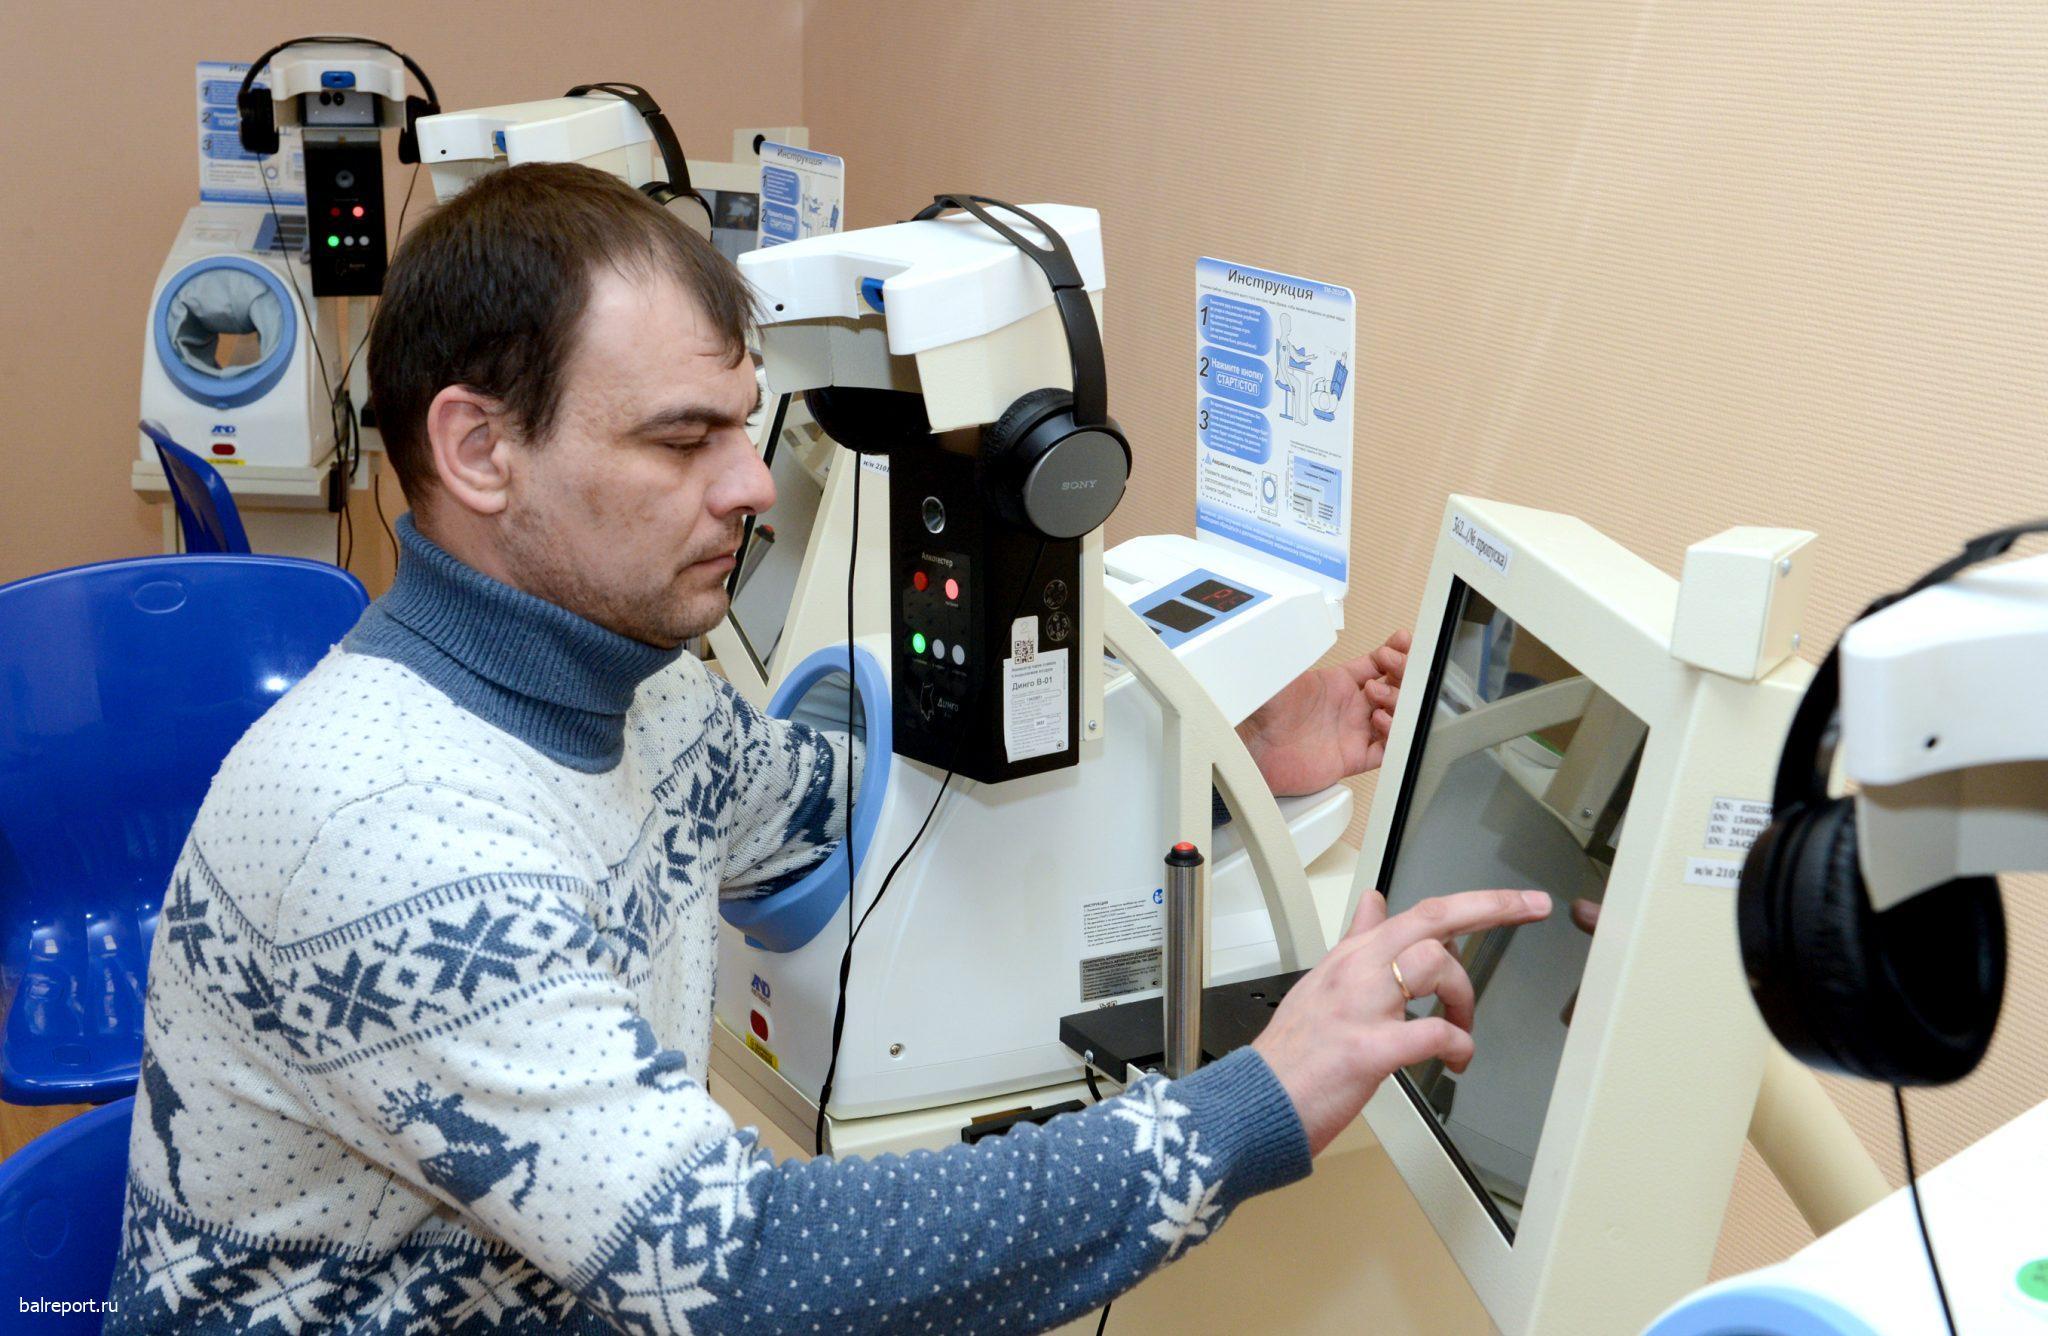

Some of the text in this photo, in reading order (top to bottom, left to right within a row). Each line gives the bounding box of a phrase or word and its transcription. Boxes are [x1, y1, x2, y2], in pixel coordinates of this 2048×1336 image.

[1227, 268, 1314, 301] Инструкция
[1200, 306, 1208, 326] 1
[1200, 357, 1209, 378] 2
[1211, 357, 1264, 382] Нажмите кнопку
[1199, 410, 1209, 430] 3
[1062, 480, 1097, 490] SONY
[1012, 681, 1035, 691] Динго
